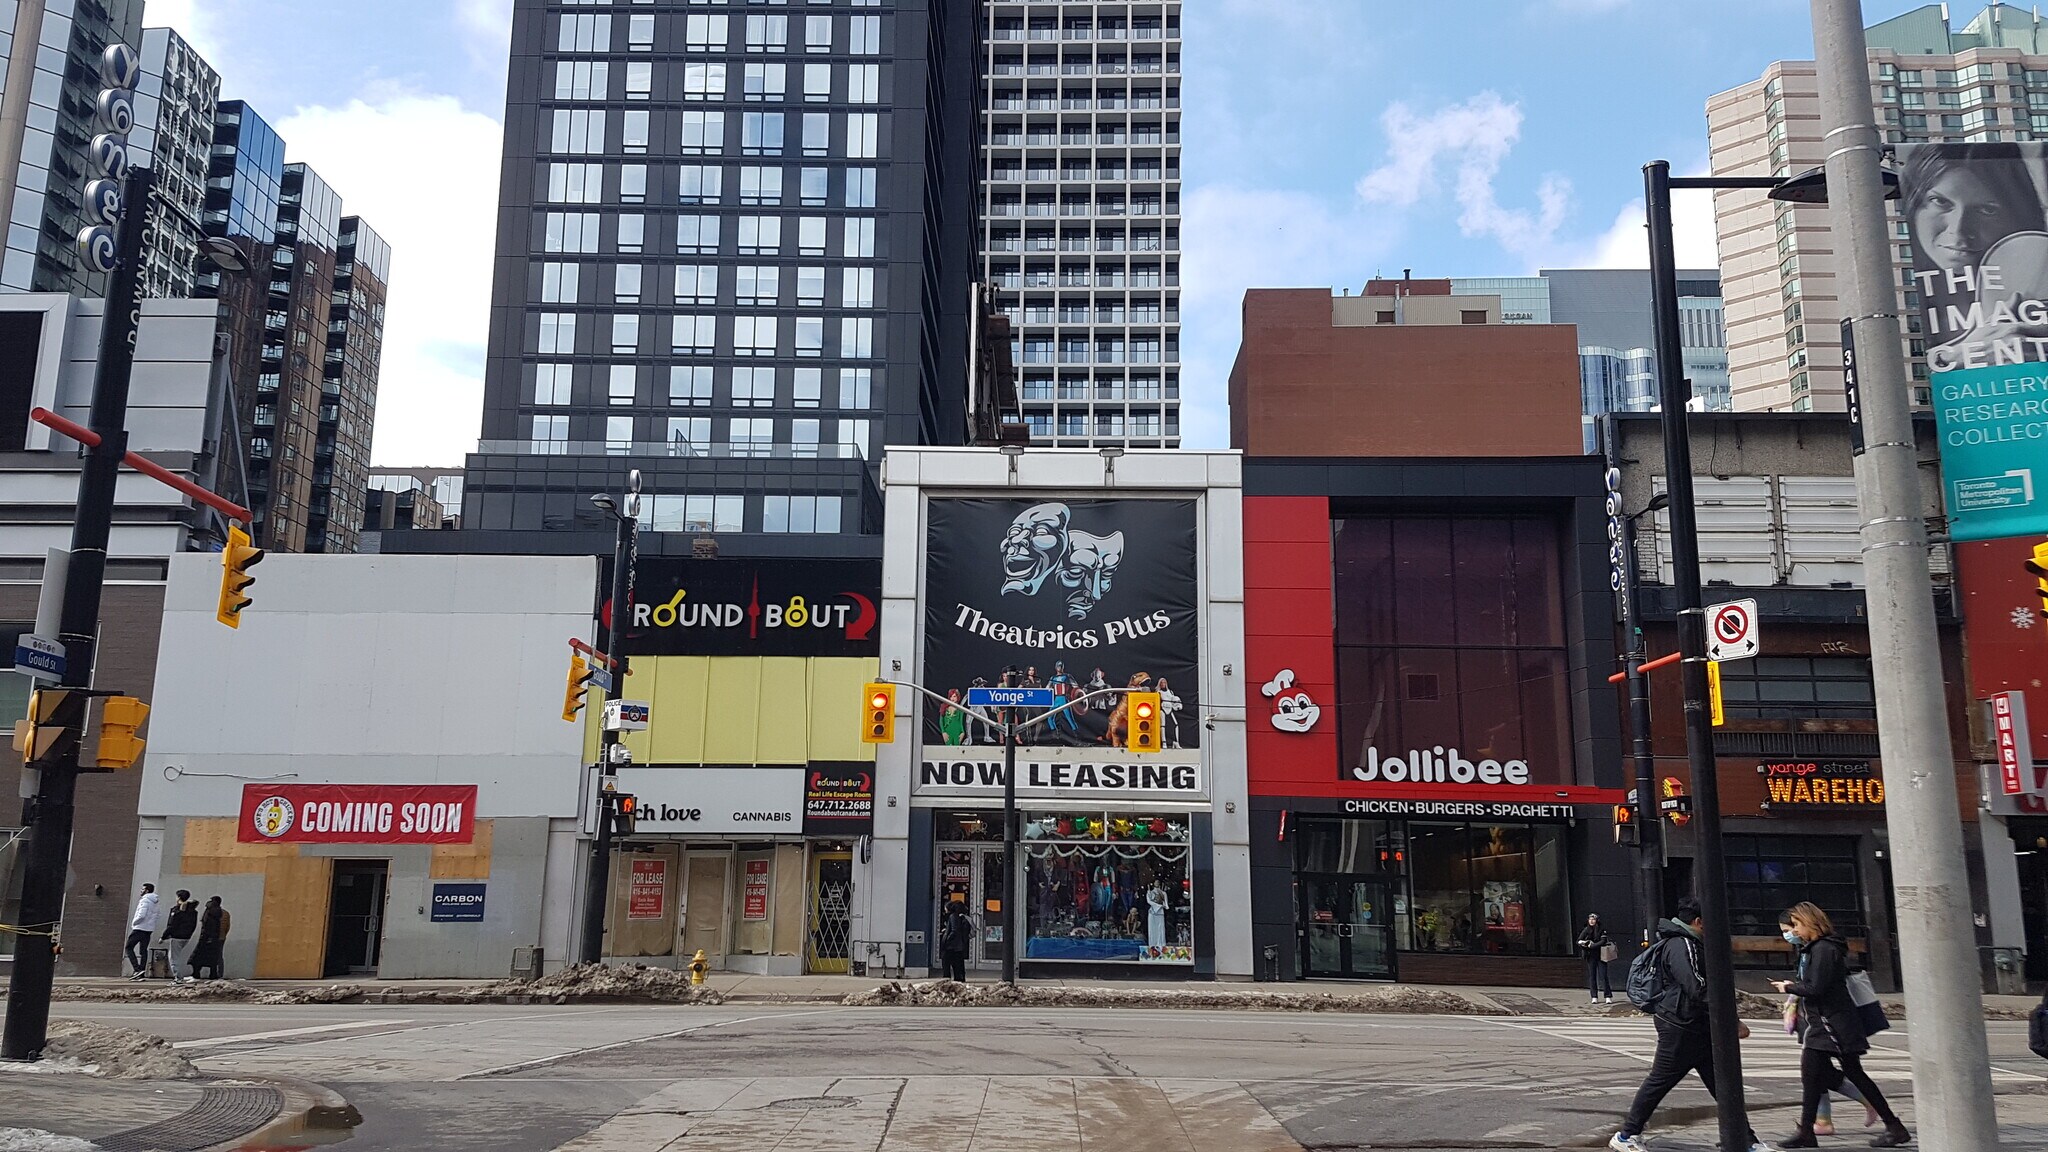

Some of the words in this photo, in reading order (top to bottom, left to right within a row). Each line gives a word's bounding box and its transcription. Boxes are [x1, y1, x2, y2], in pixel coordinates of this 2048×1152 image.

[126, 184, 158, 347] DOWNTOWN
[1914, 265, 2005, 297] THE
[1927, 300, 2048, 335] IMAG
[1844, 349, 1859, 424] 341C
[1959, 481, 1997, 490] Toronto
[1960, 487, 2023, 498] Metropolitan
[1961, 496, 2011, 507] University
[633, 589, 744, 628] ROUND
[765, 596, 850, 628] BOUT
[955, 603, 1099, 650] Theatrics
[1103, 609, 1171, 645] Plus
[28, 651, 50, 668] Gould
[988, 690, 1025, 705] Yonge
[1998, 716, 2016, 778] MART
[1353, 745, 1529, 785] Jollibee
[1767, 763, 1816, 776] yonge
[1823, 762, 1869, 773] street
[817, 778, 840, 787] ROUND
[921, 762, 1006, 785] NOW
[1029, 763, 1196, 789] LEASING
[833, 791, 854, 799] Escape
[660, 803, 702, 821] love
[807, 800, 871, 809] 647.712.2688
[302, 802, 393, 834] COMING
[400, 802, 463, 833] SOON
[732, 812, 792, 822] CANNABIS
[632, 872, 645, 885] FOR
[645, 872, 664, 885] LEASE
[746, 873, 755, 885] FOR
[755, 873, 768, 885] LEASE
[946, 866, 969, 877] CLOSED
[435, 895, 483, 903] CARBON
